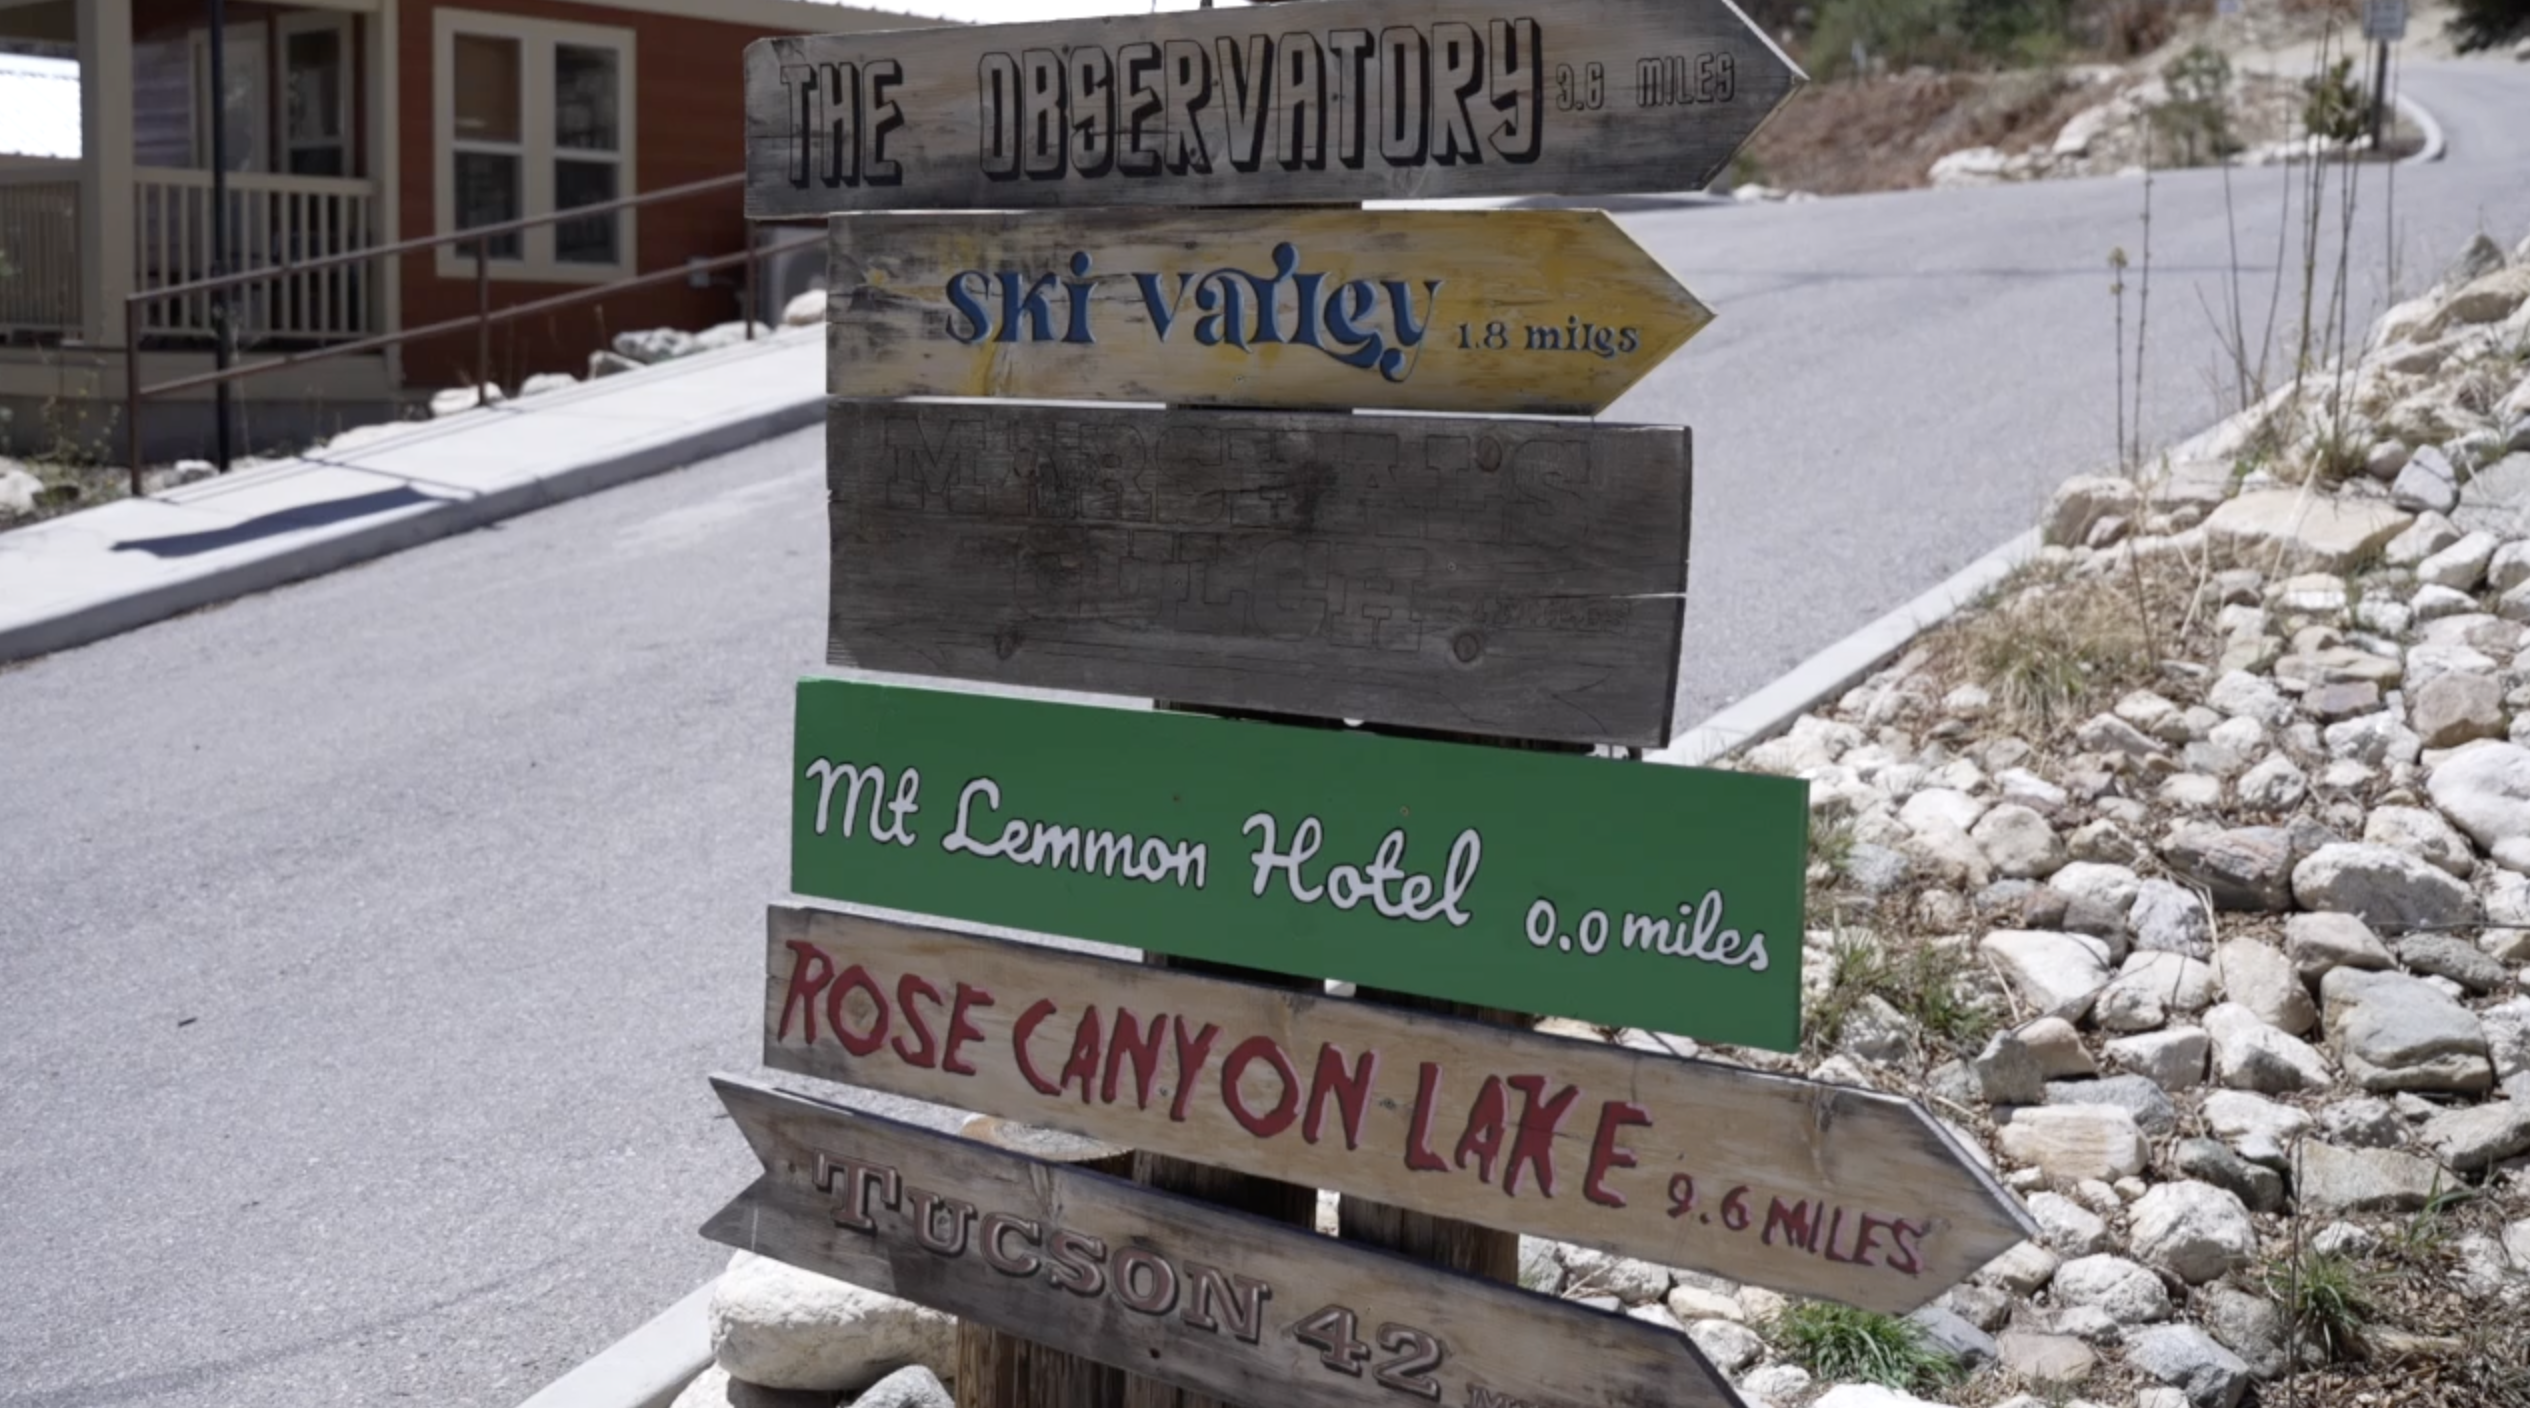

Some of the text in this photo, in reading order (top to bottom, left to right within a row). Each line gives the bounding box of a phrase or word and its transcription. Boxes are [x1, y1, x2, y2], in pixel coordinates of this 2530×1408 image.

[780, 16, 1735, 188] THE OBSERVATORY 3.6 MILES
[1457, 319, 1508, 351] 1.8
[1524, 315, 1641, 359] miles
[804, 756, 1770, 971] Mt Lemmon Hotel 0.0 miles
[778, 939, 1930, 1277] ROSE CANYON LAKE 9.6 MILES
[811, 1147, 1442, 1400] TUCSON 42
